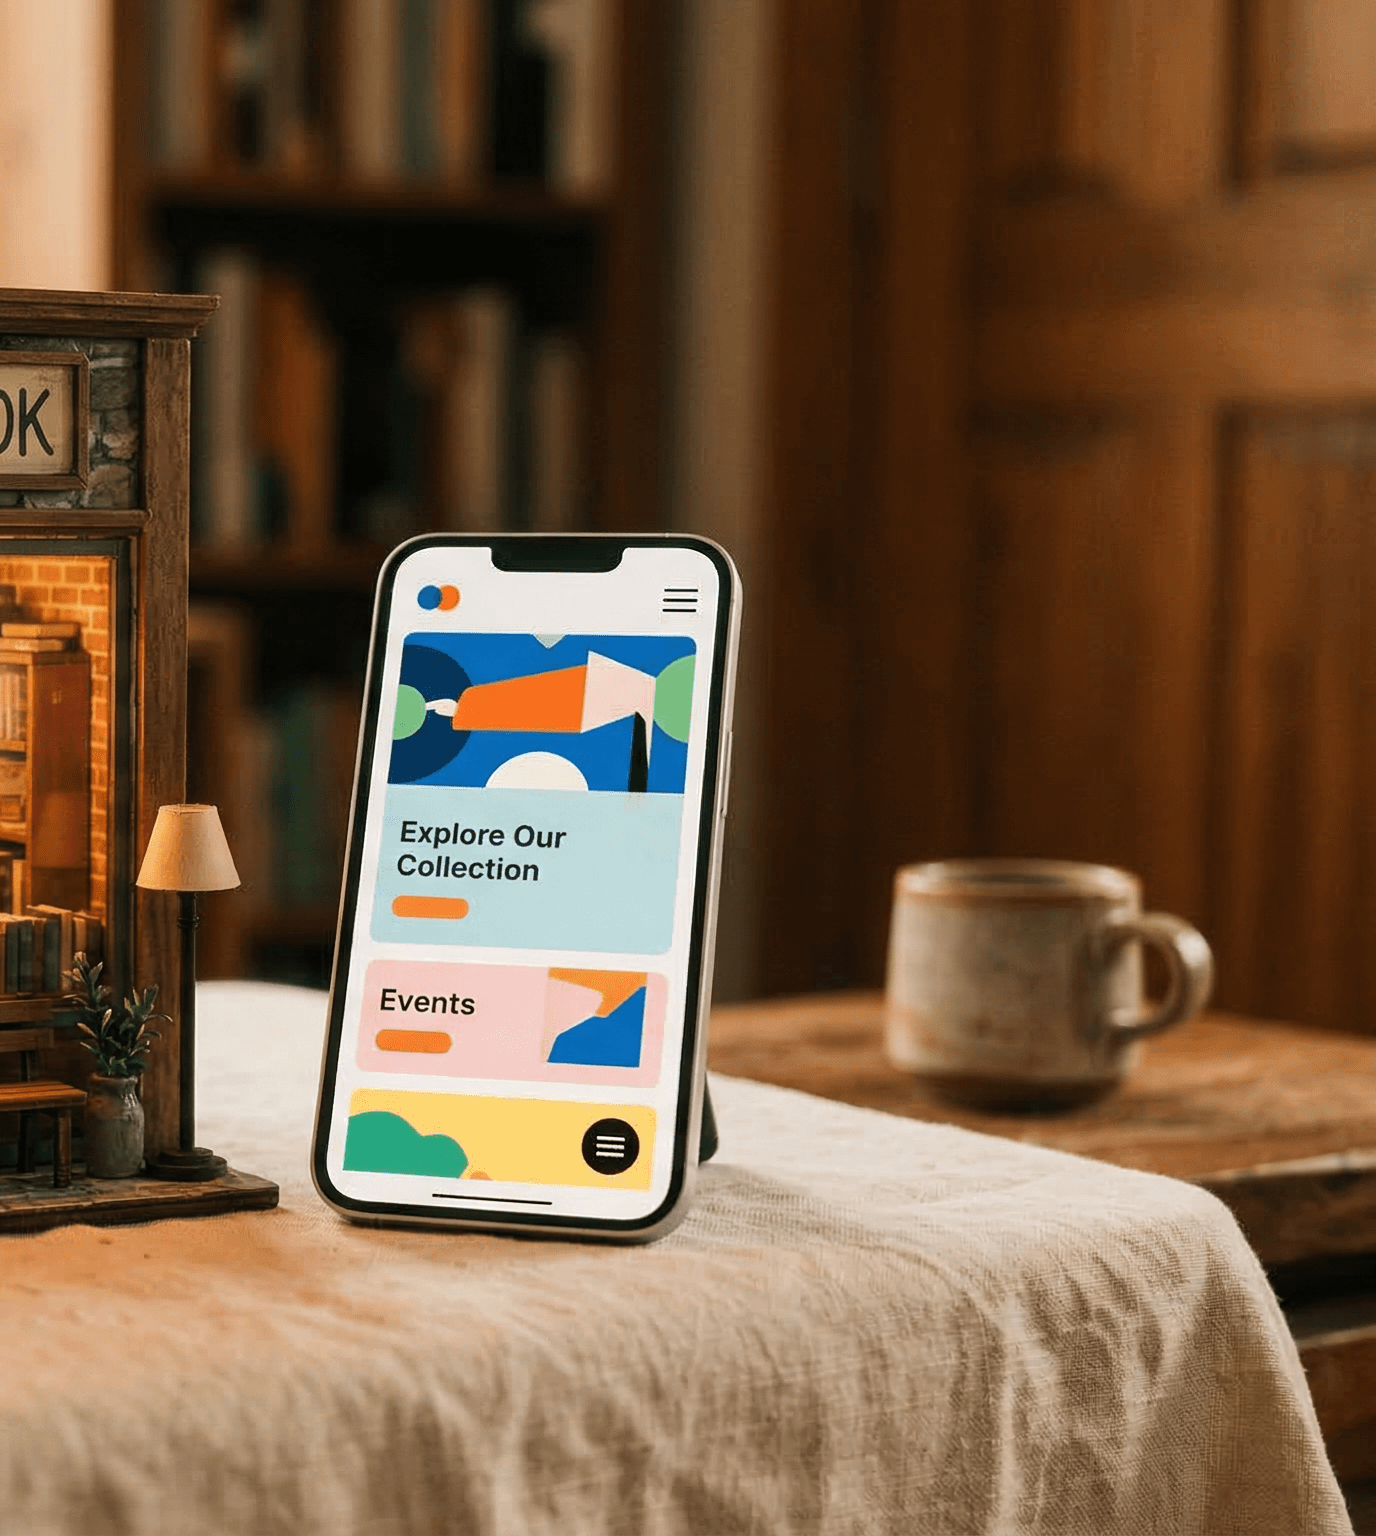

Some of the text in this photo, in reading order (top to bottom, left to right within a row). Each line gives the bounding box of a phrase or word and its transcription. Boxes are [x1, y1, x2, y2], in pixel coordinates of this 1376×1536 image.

[400, 820, 567, 849] Explore Our
[396, 854, 539, 881] Collection
[380, 988, 475, 1016] Events
